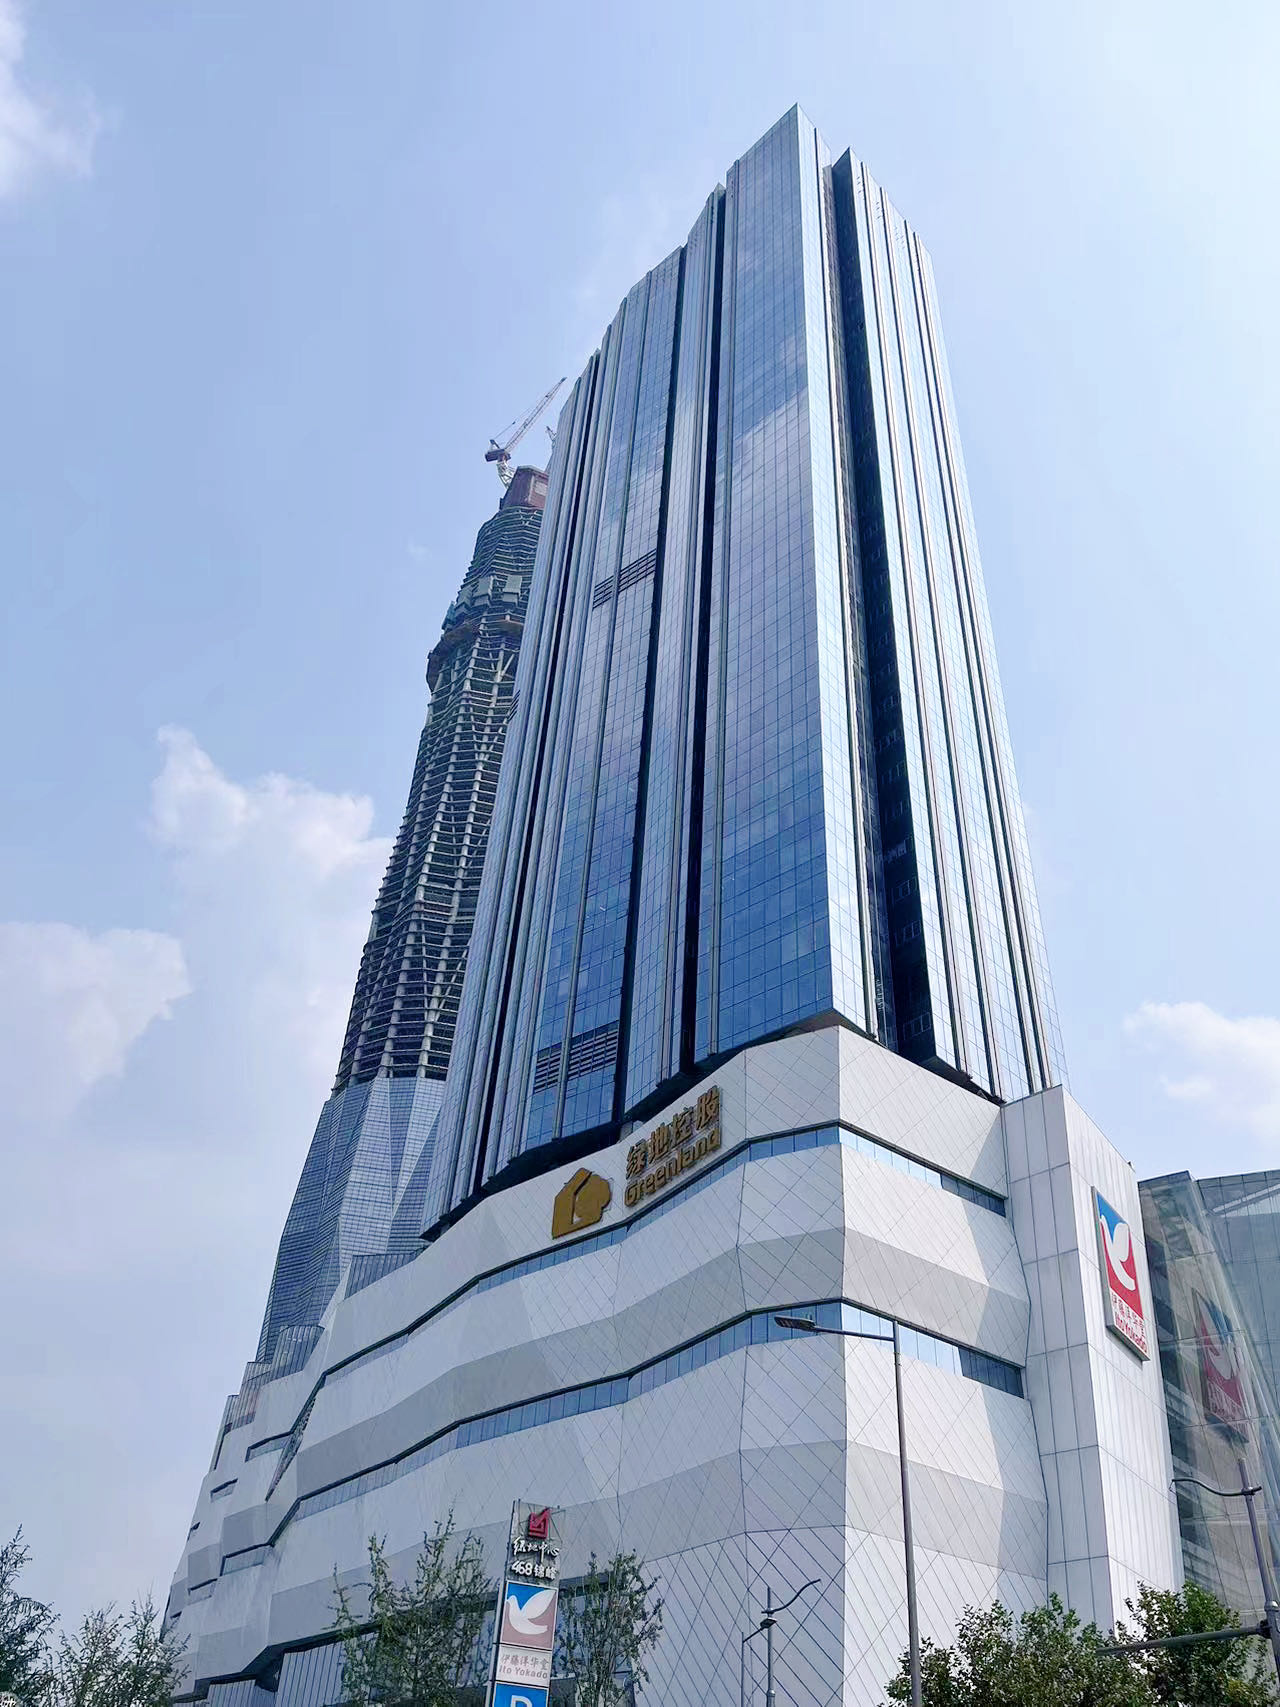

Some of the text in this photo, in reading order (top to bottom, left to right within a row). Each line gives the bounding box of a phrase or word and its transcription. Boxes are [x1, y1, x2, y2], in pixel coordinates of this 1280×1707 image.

[626, 1085, 720, 1180] 绿地控股
[625, 1128, 721, 1206] Greenland
[513, 1535, 560, 1563] 绿地中心
[499, 1665, 548, 1679] Ito Yokado
[501, 1653, 548, 1670] 伊藤洋华堂
